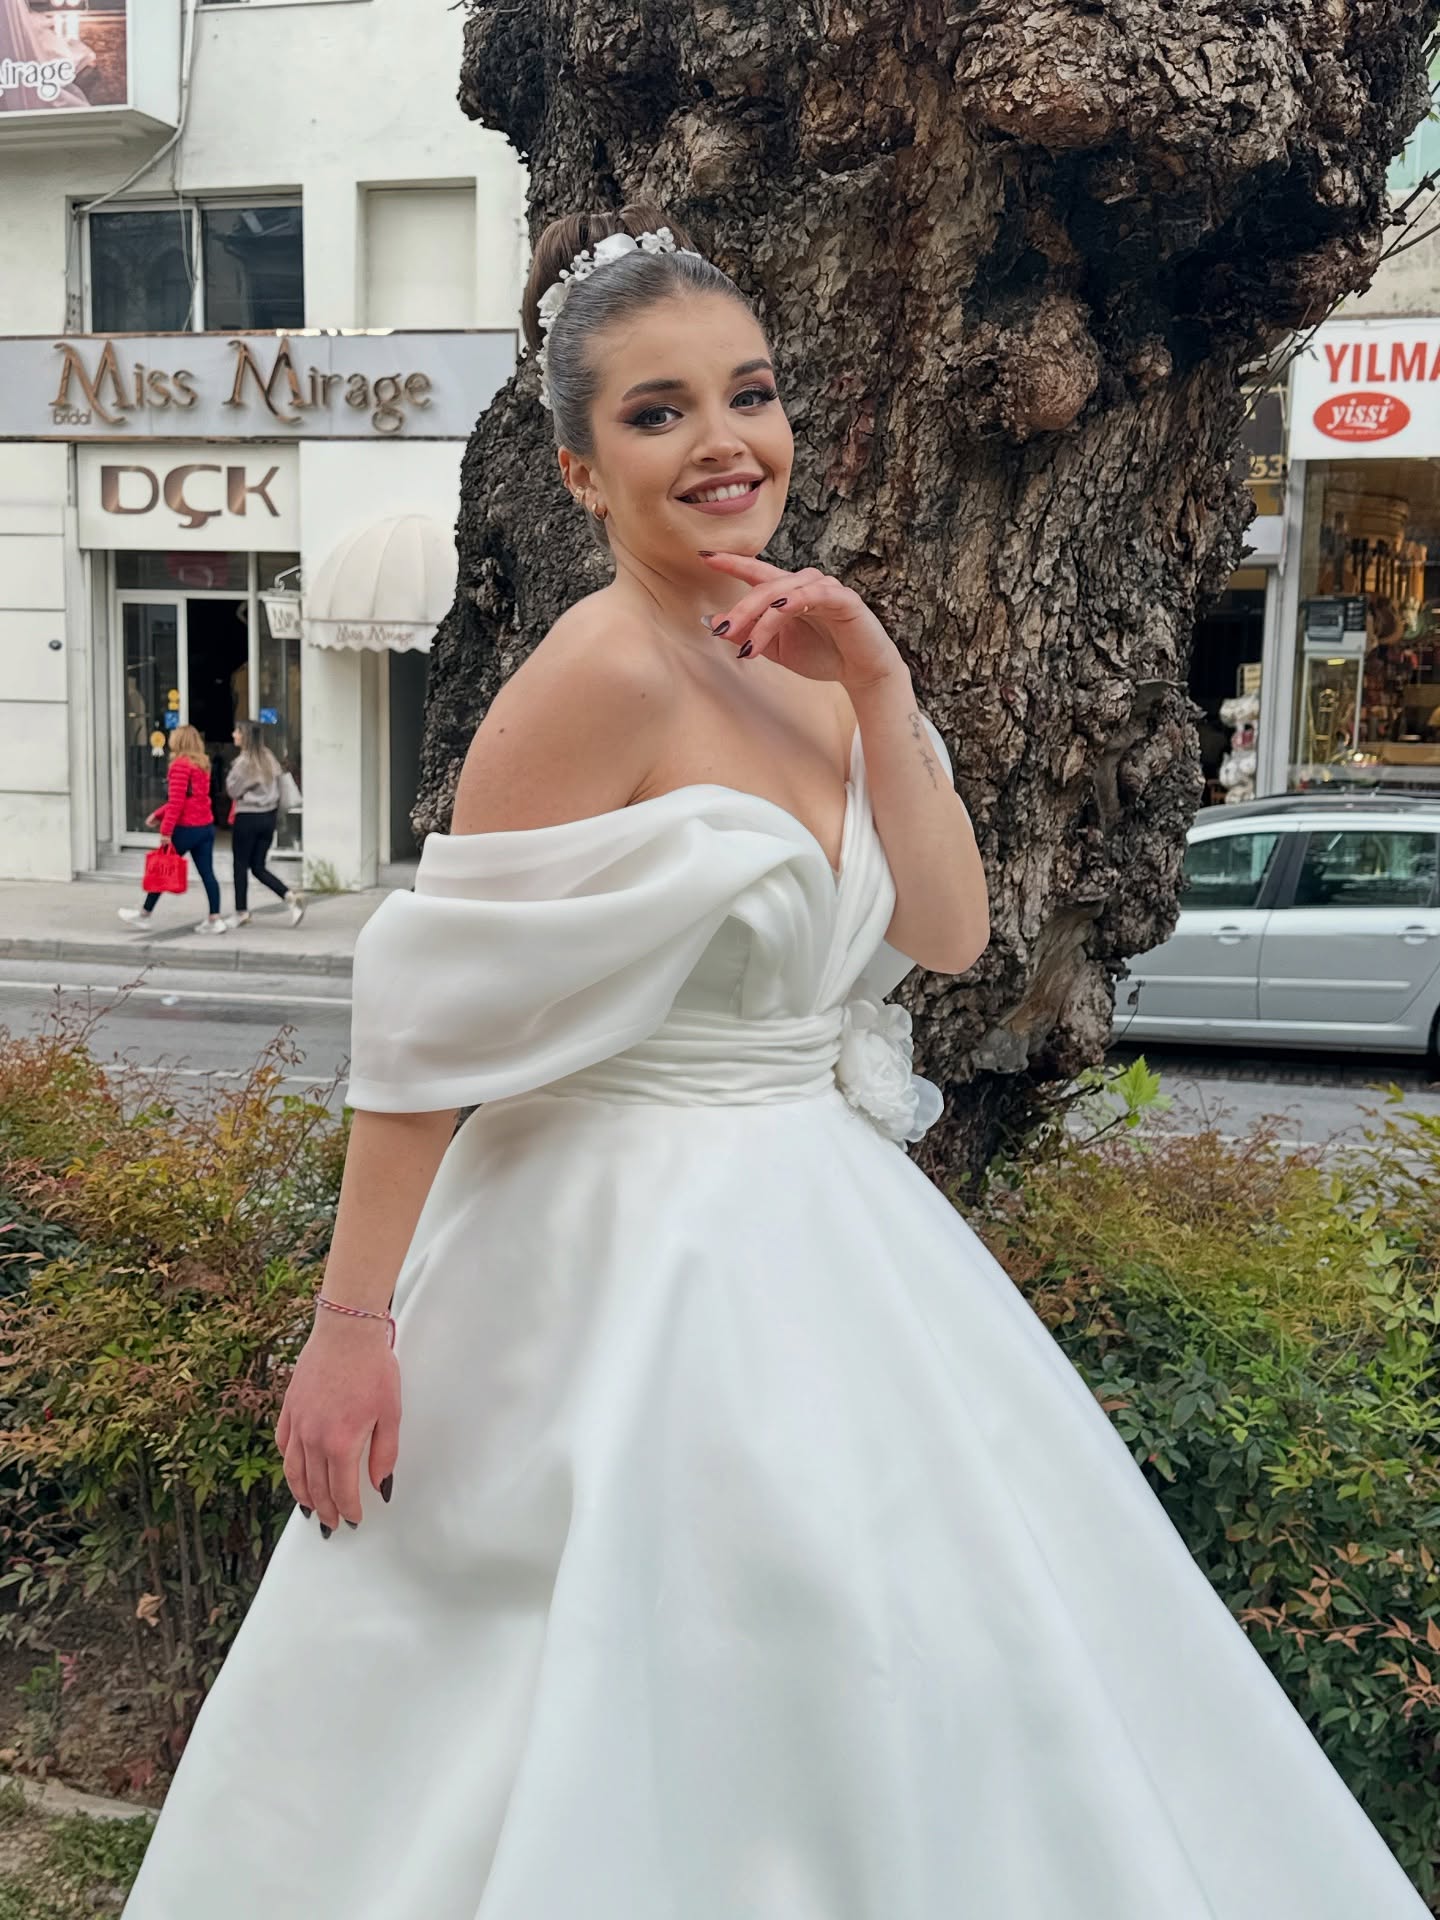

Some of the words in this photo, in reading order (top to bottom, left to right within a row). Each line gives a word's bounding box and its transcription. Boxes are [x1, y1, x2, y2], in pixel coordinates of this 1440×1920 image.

[0, 61, 73, 98] irage
[48, 340, 199, 425] Miss
[222, 337, 432, 433] Mirage
[1326, 398, 1392, 430] yissi
[101, 464, 281, 529] DÇK
